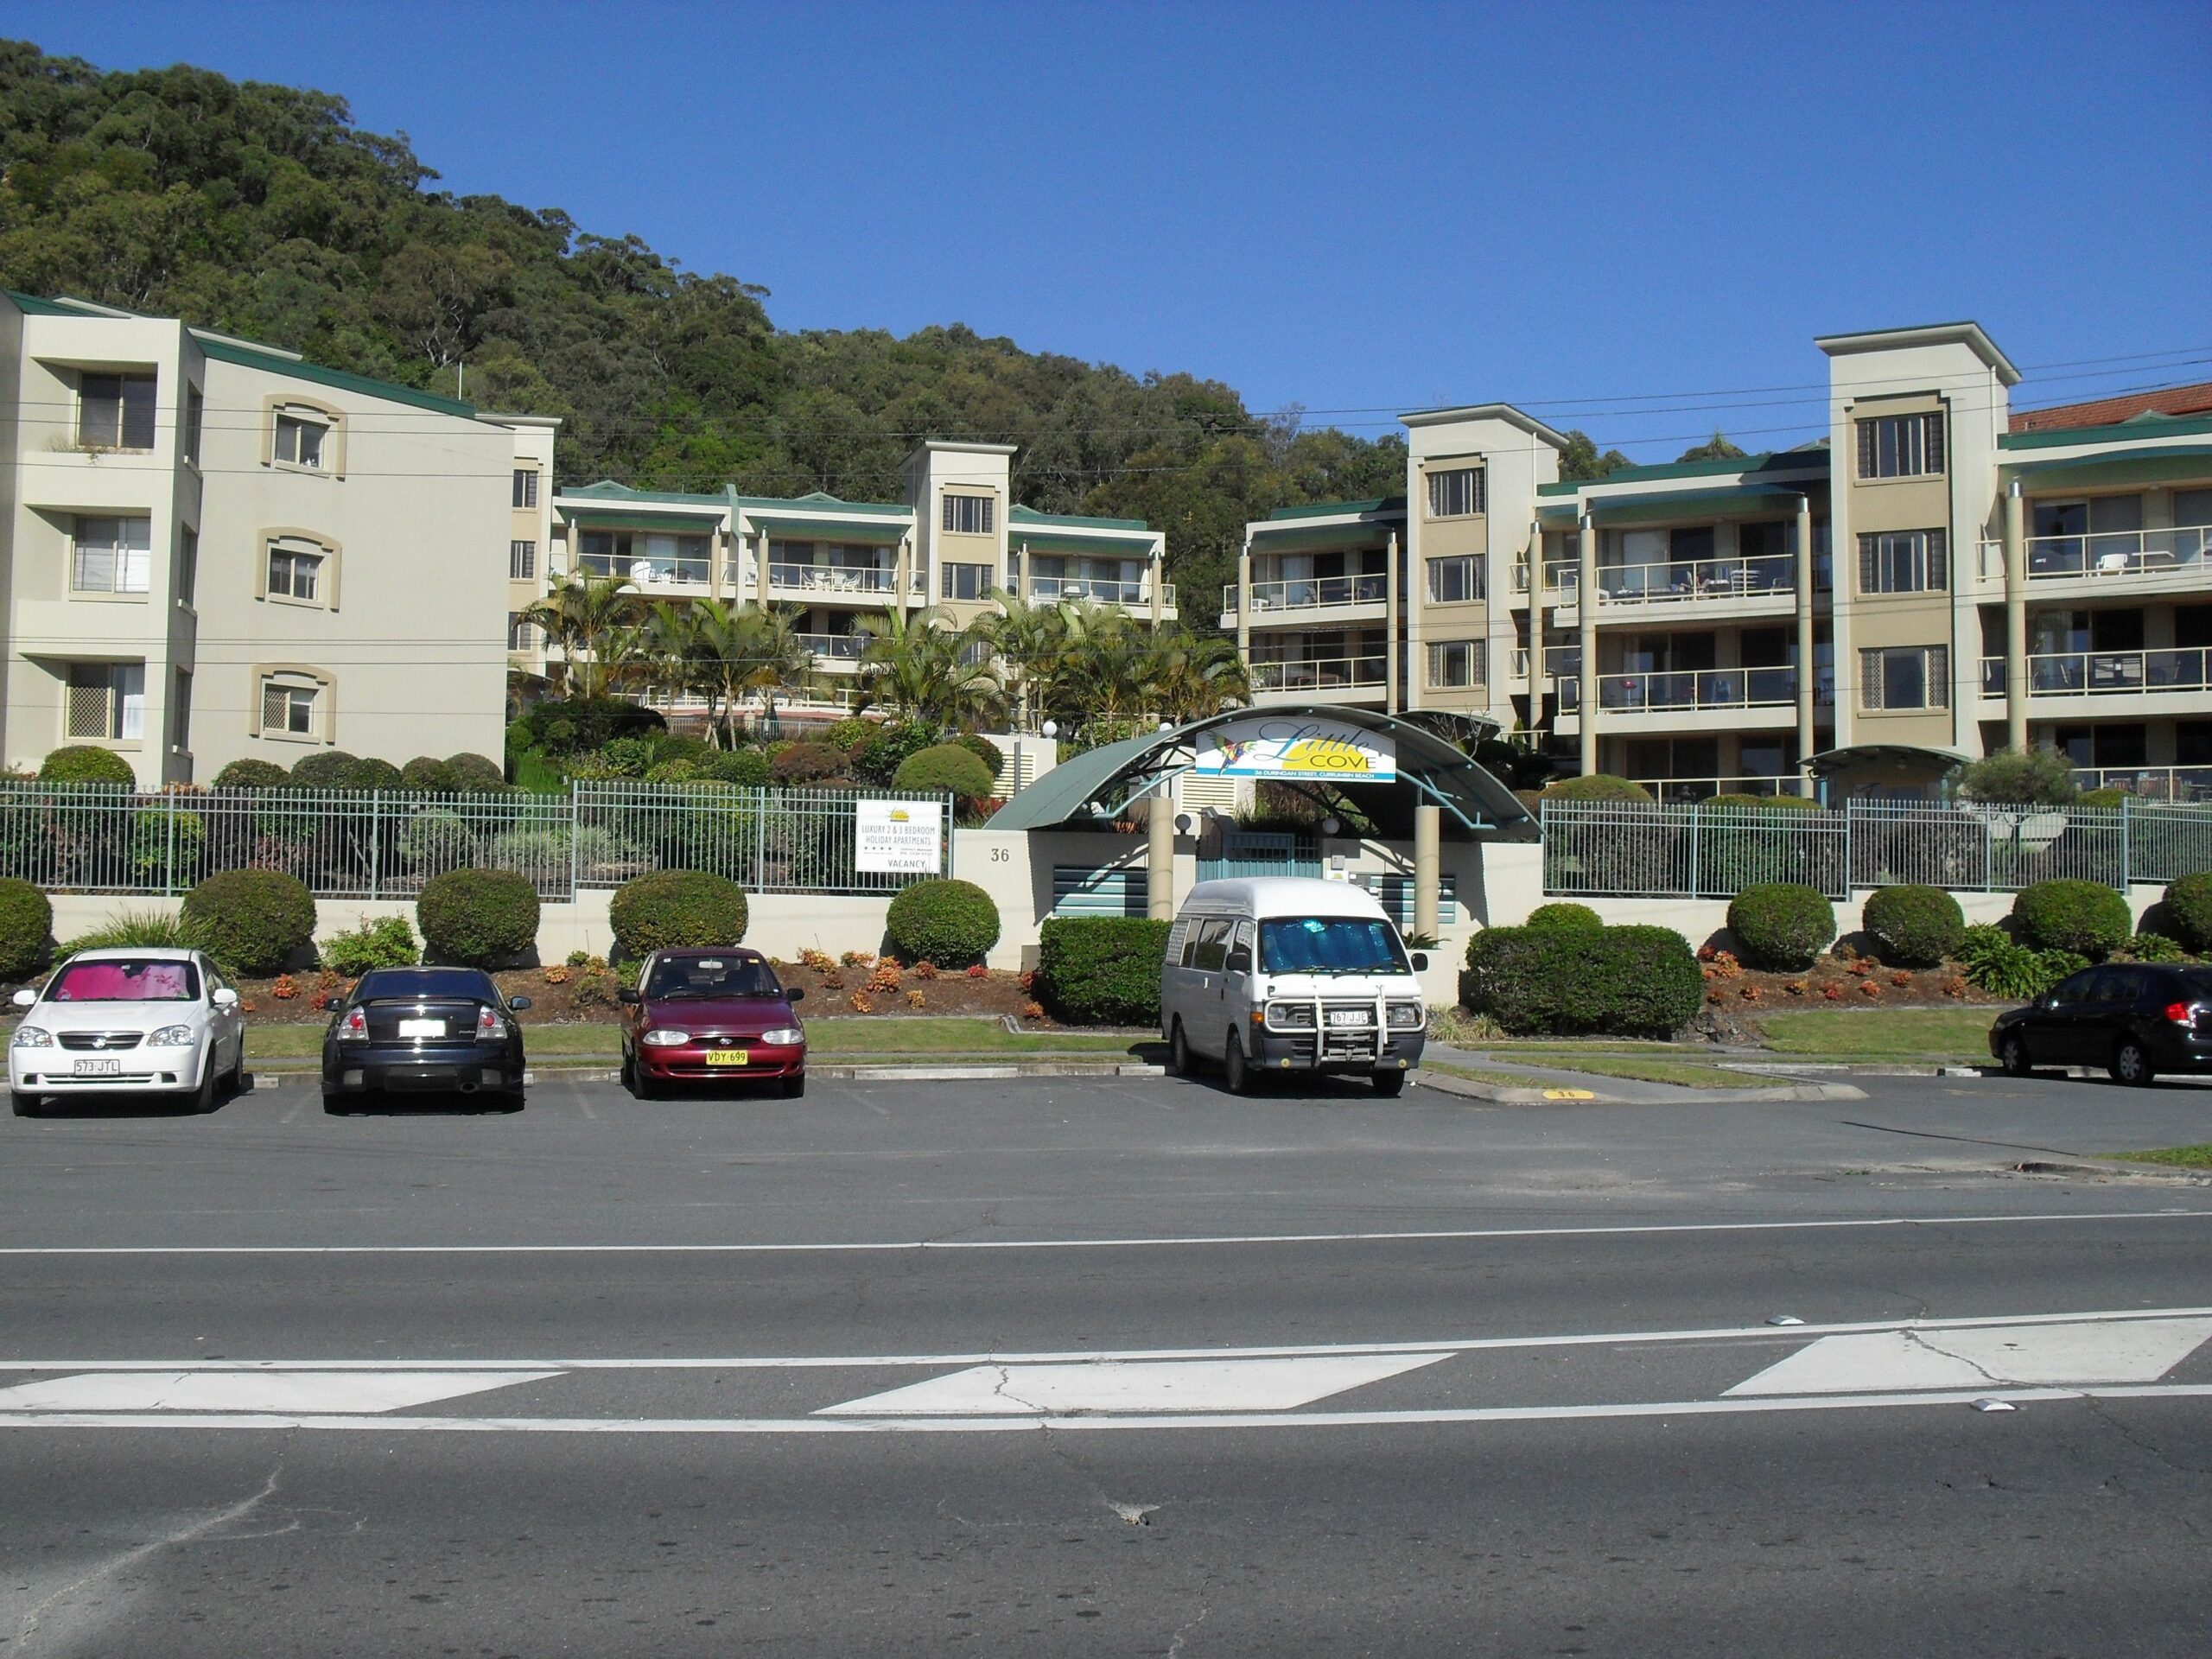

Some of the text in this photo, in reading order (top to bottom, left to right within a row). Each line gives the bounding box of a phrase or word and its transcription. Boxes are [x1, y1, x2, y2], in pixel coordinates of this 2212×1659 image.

[1254, 722, 1370, 761] Little
[1310, 754, 1376, 769] COVE
[861, 825, 886, 834] LUXURY
[893, 826, 897, 835] &
[899, 826, 903, 835] 3
[905, 826, 935, 835] BEDROOM
[866, 836, 931, 846] HOLIDAY APARTMENTS
[991, 848, 1009, 862] 36
[888, 859, 925, 868] VACANCY
[709, 1052, 746, 1062] VDY 699
